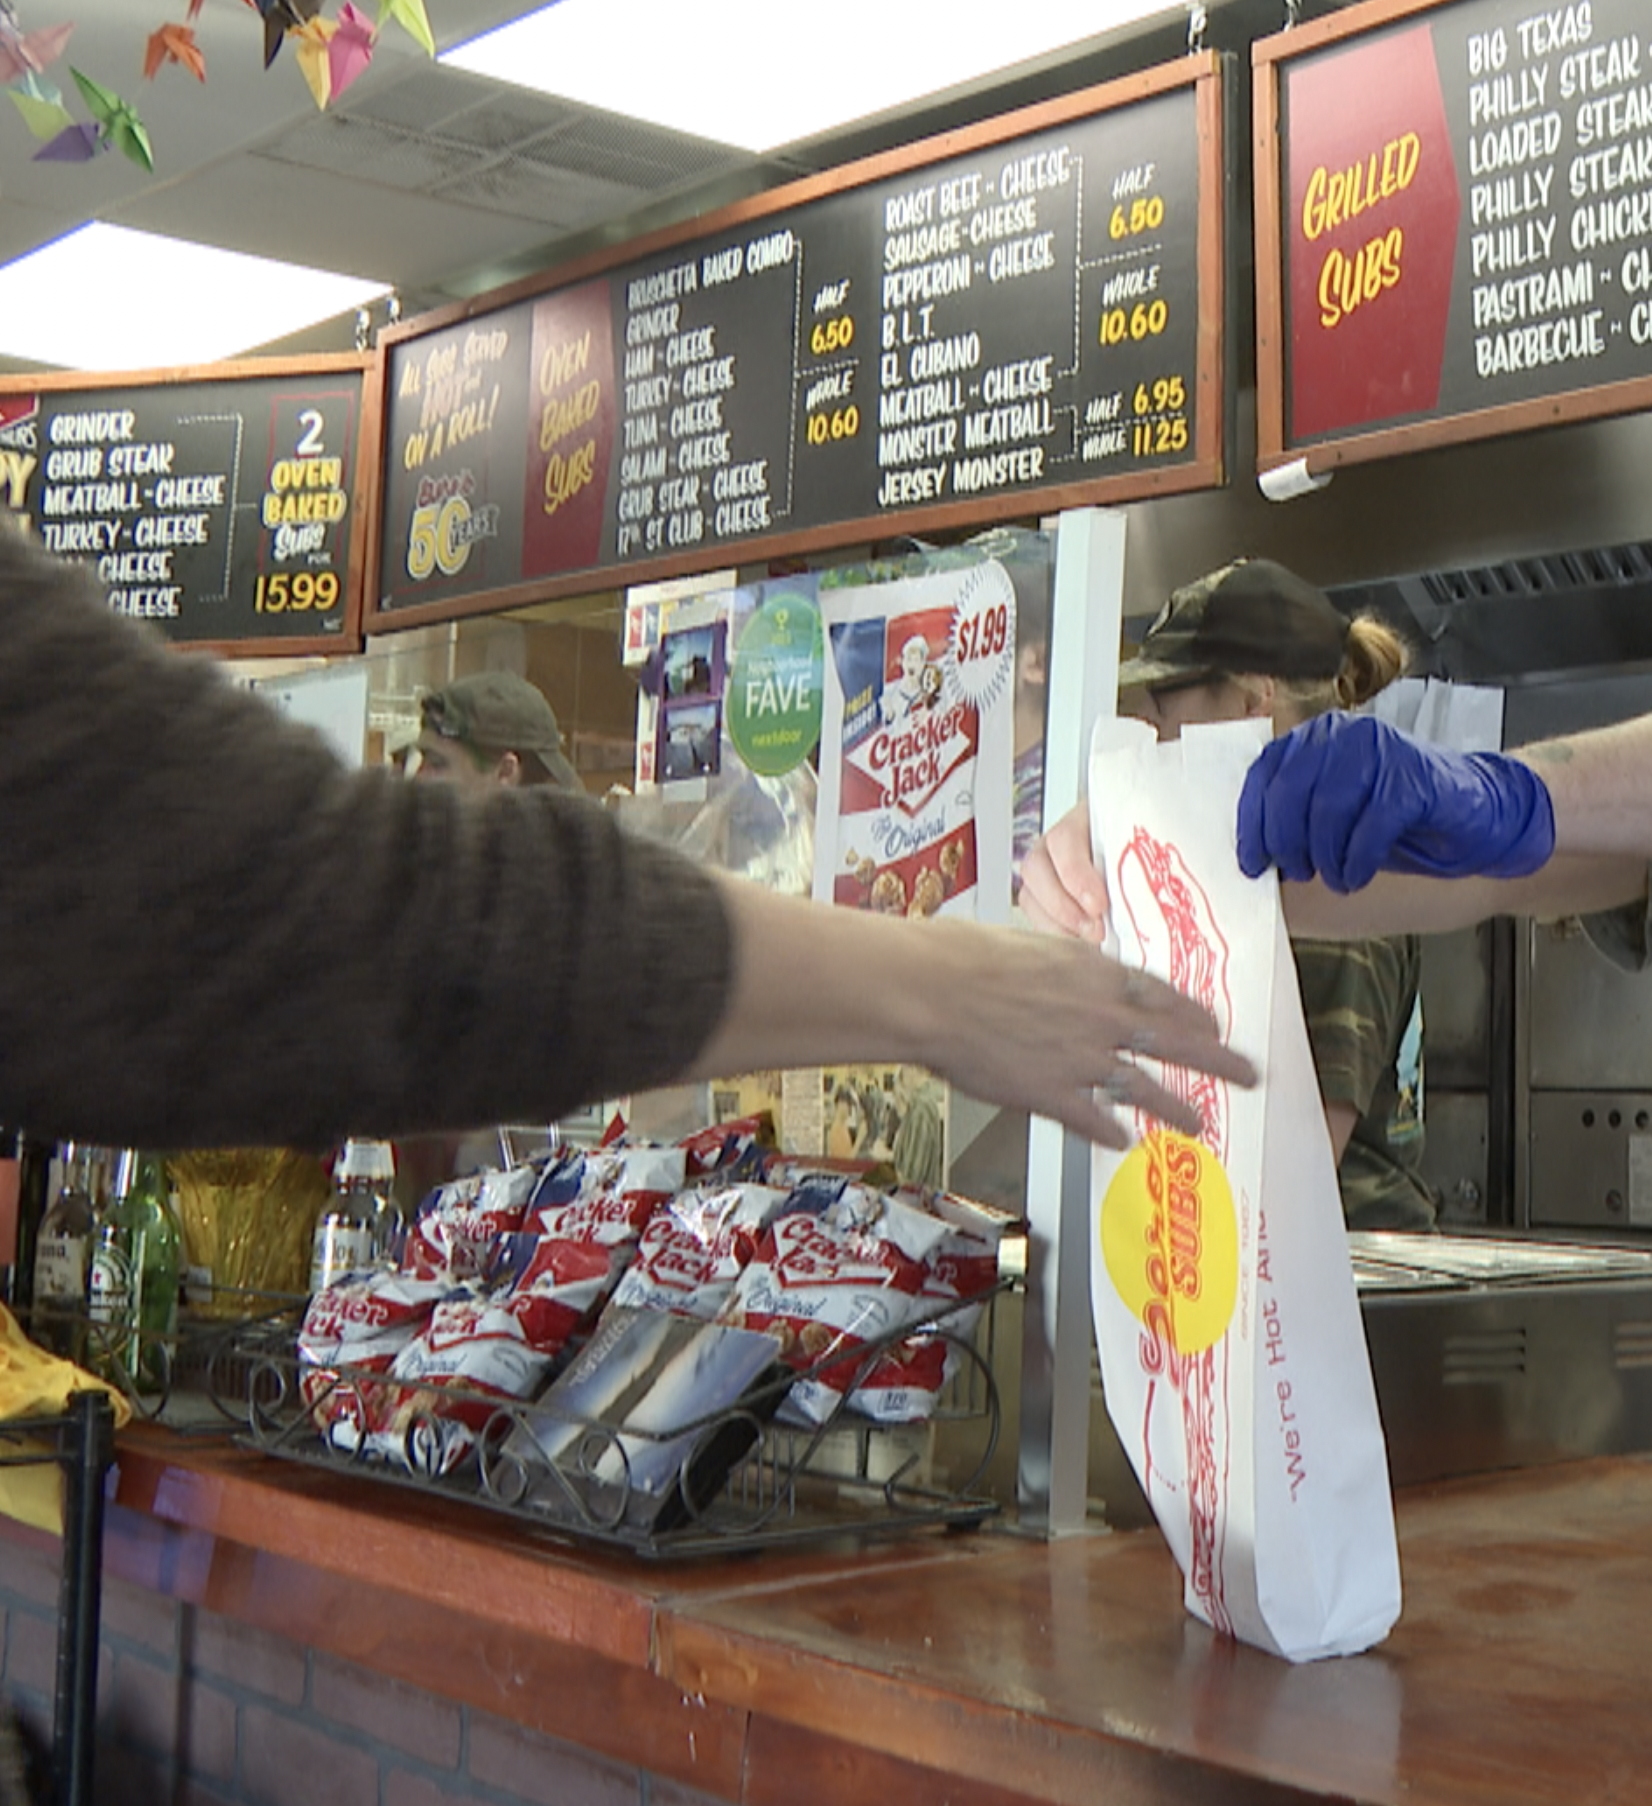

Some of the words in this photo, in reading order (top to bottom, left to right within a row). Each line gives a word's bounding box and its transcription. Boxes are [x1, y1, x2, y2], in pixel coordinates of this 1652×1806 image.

[1468, 27, 1507, 75] BIG
[1517, 0, 1593, 60] TEXAS
[1469, 64, 1549, 127] PHILLY
[1559, 35, 1642, 98] STEAK
[1469, 111, 1562, 176] LOADED
[886, 184, 935, 232] ROAST
[939, 173, 982, 217] BEEF
[1000, 146, 1071, 200] CHEESE
[1112, 164, 1155, 199] HALF
[1470, 166, 1554, 225] PHILLY
[1109, 196, 1164, 240] 6.50
[703, 247, 743, 288] BAKED
[747, 229, 794, 275] COMBO
[883, 255, 971, 310] PEPPERONI
[989, 231, 1055, 283] CHEESE
[1471, 215, 1556, 277] PHILLY
[814, 279, 850, 314] HALF
[1103, 265, 1161, 306] WHOLE
[1472, 261, 1593, 328] PASTRAMI
[626, 303, 680, 346] GRINDER
[811, 316, 853, 354] 6.50
[1099, 299, 1168, 345] 10.60
[1475, 310, 1605, 378] BARBECUE
[540, 330, 590, 396] OVEN
[625, 345, 654, 380] HAM
[666, 327, 716, 368] CHEESE
[881, 352, 902, 388] EL
[911, 331, 980, 379] CUBANO
[625, 375, 673, 413] TURKEY
[683, 356, 735, 399] CHEESE
[806, 371, 854, 411] WHOLE
[879, 379, 966, 428] MEATBALL
[983, 356, 1053, 404] CHEESE
[1085, 392, 1122, 422] HALF
[1133, 376, 1184, 416] 6.95
[50, 410, 135, 443] GRINDER
[298, 411, 324, 453] 2
[540, 380, 599, 451] BAKED
[624, 415, 658, 449] TUNA
[671, 398, 723, 439] CHEESE
[807, 405, 859, 444] 10.60
[879, 418, 957, 467] MONSTER
[965, 398, 1055, 450] MEATBALL
[1083, 428, 1126, 461] WHOLE
[1133, 417, 1188, 457] 11.25
[47, 449, 101, 481] GRUB
[108, 444, 174, 476] STEAK
[272, 458, 342, 492] OVEN
[621, 447, 667, 486] SALAMI
[679, 432, 731, 473] CHEESE
[878, 464, 947, 507] JERSEY
[953, 446, 1044, 494] MONSTER
[44, 482, 142, 515] MEATBALL
[156, 476, 226, 508] CHEESE
[264, 491, 348, 527] BAKED
[619, 484, 653, 521] GRUB
[659, 475, 700, 513] STEAK
[713, 461, 768, 501] CHEESE
[43, 520, 122, 551] TURKEY
[135, 514, 209, 545] CHEESE
[646, 516, 664, 551] ST
[669, 509, 703, 548] CLUB
[716, 497, 771, 537] CHEESE
[99, 551, 173, 583] CHEESE
[255, 572, 338, 613] 15.99
[110, 587, 181, 617] CHEESE
[957, 604, 1008, 663] $1.99
[745, 670, 811, 719] FAVE
[869, 703, 961, 770] Cracker
[881, 751, 941, 809] Jack
[885, 805, 946, 858] Original
[1165, 1137, 1202, 1302] SUBS
[1263, 1298, 1286, 1367] Hot
